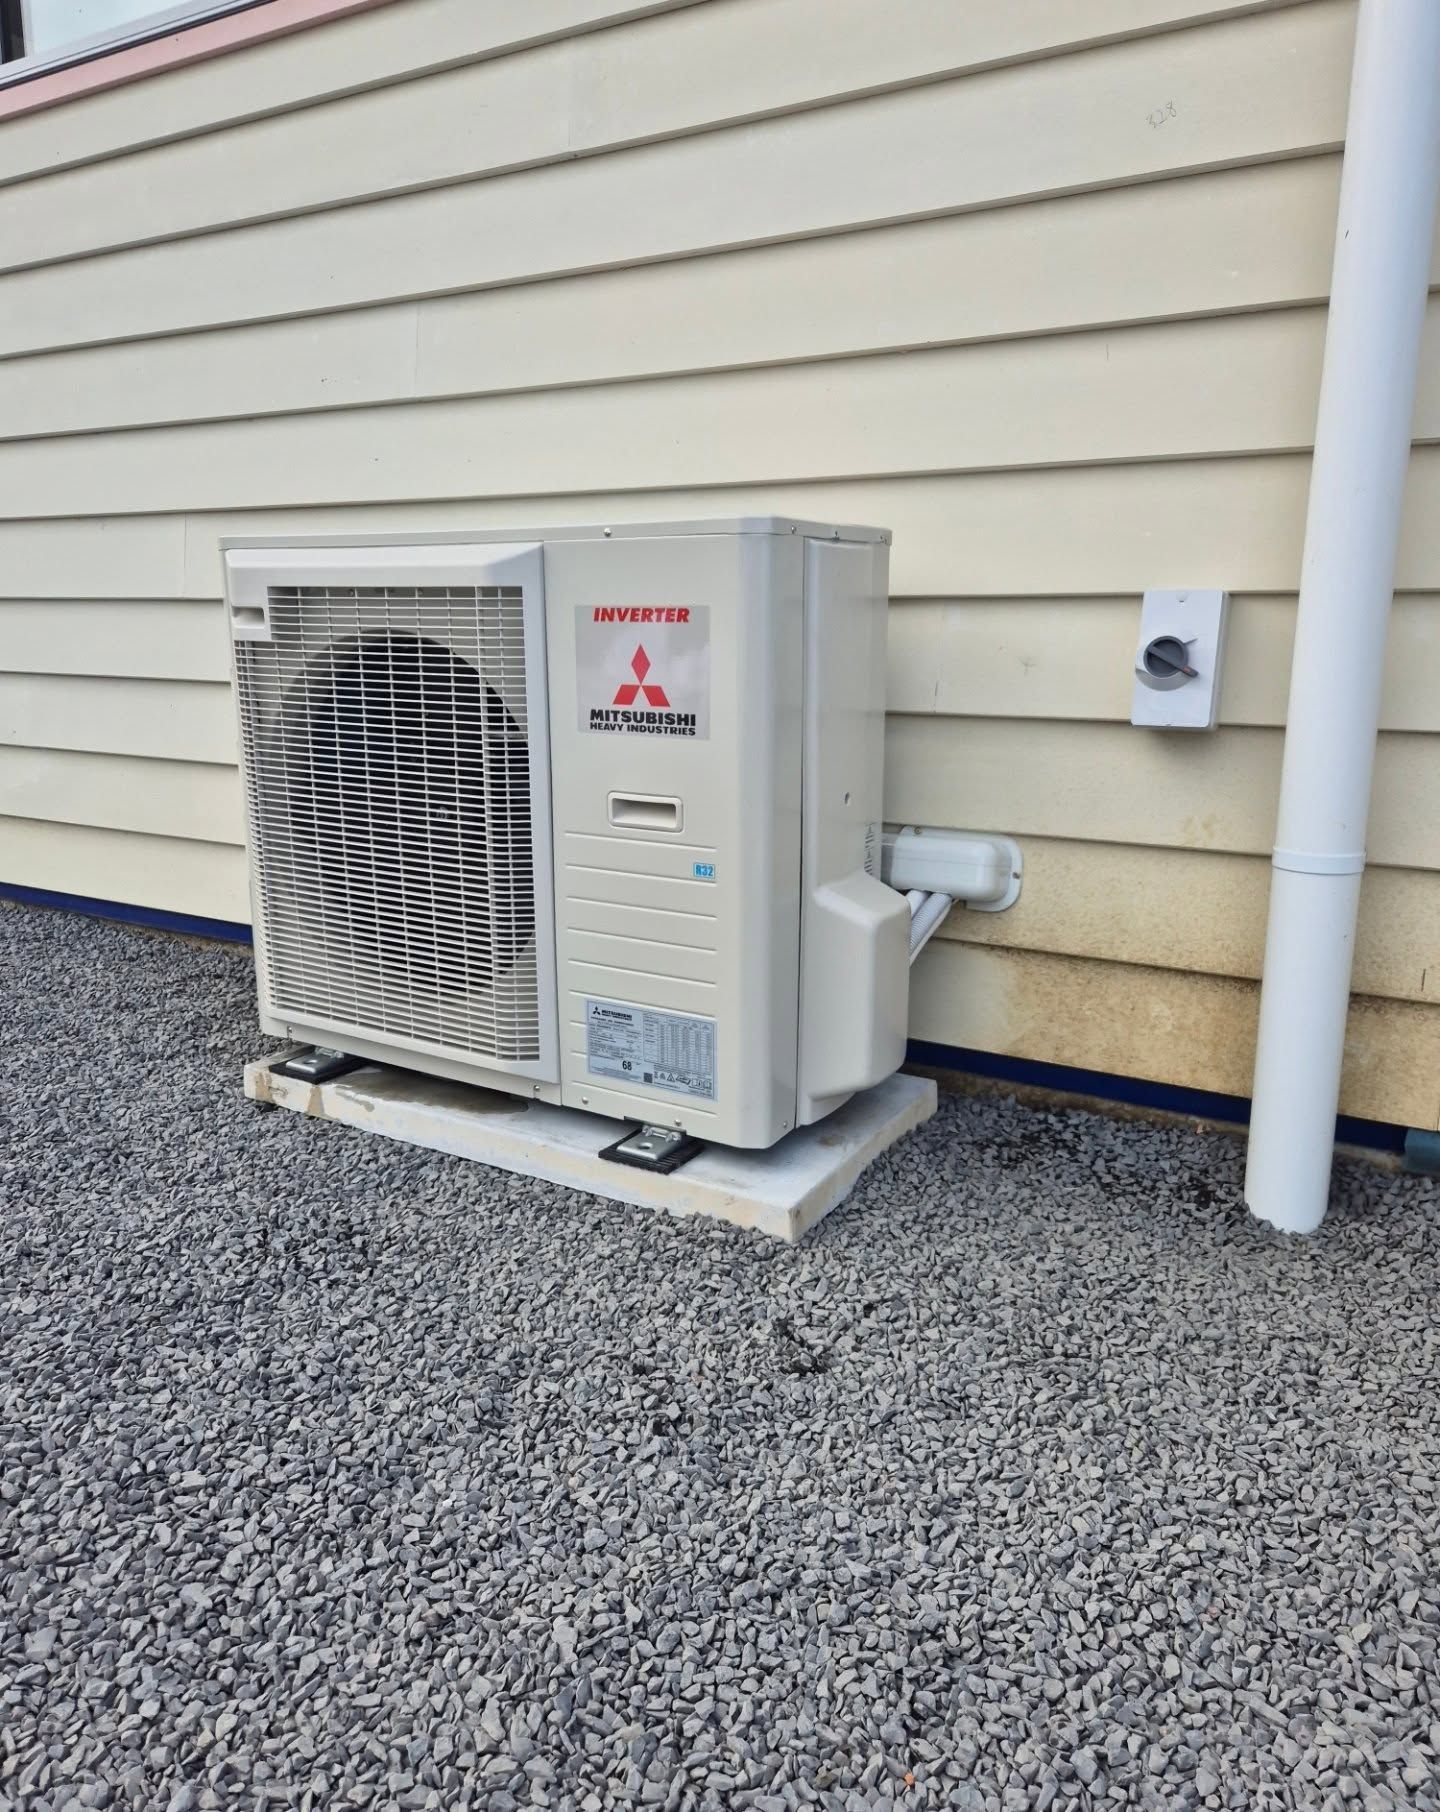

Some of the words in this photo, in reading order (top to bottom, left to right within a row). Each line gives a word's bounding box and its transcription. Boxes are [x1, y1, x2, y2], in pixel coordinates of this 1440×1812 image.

[593, 607, 690, 623] INVERTER
[590, 709, 696, 727] MITSUBISHI
[589, 722, 624, 732] HEAVY
[627, 724, 696, 736] INDUSTRIES
[695, 864, 713, 877] R32
[622, 1060, 632, 1071] 68
